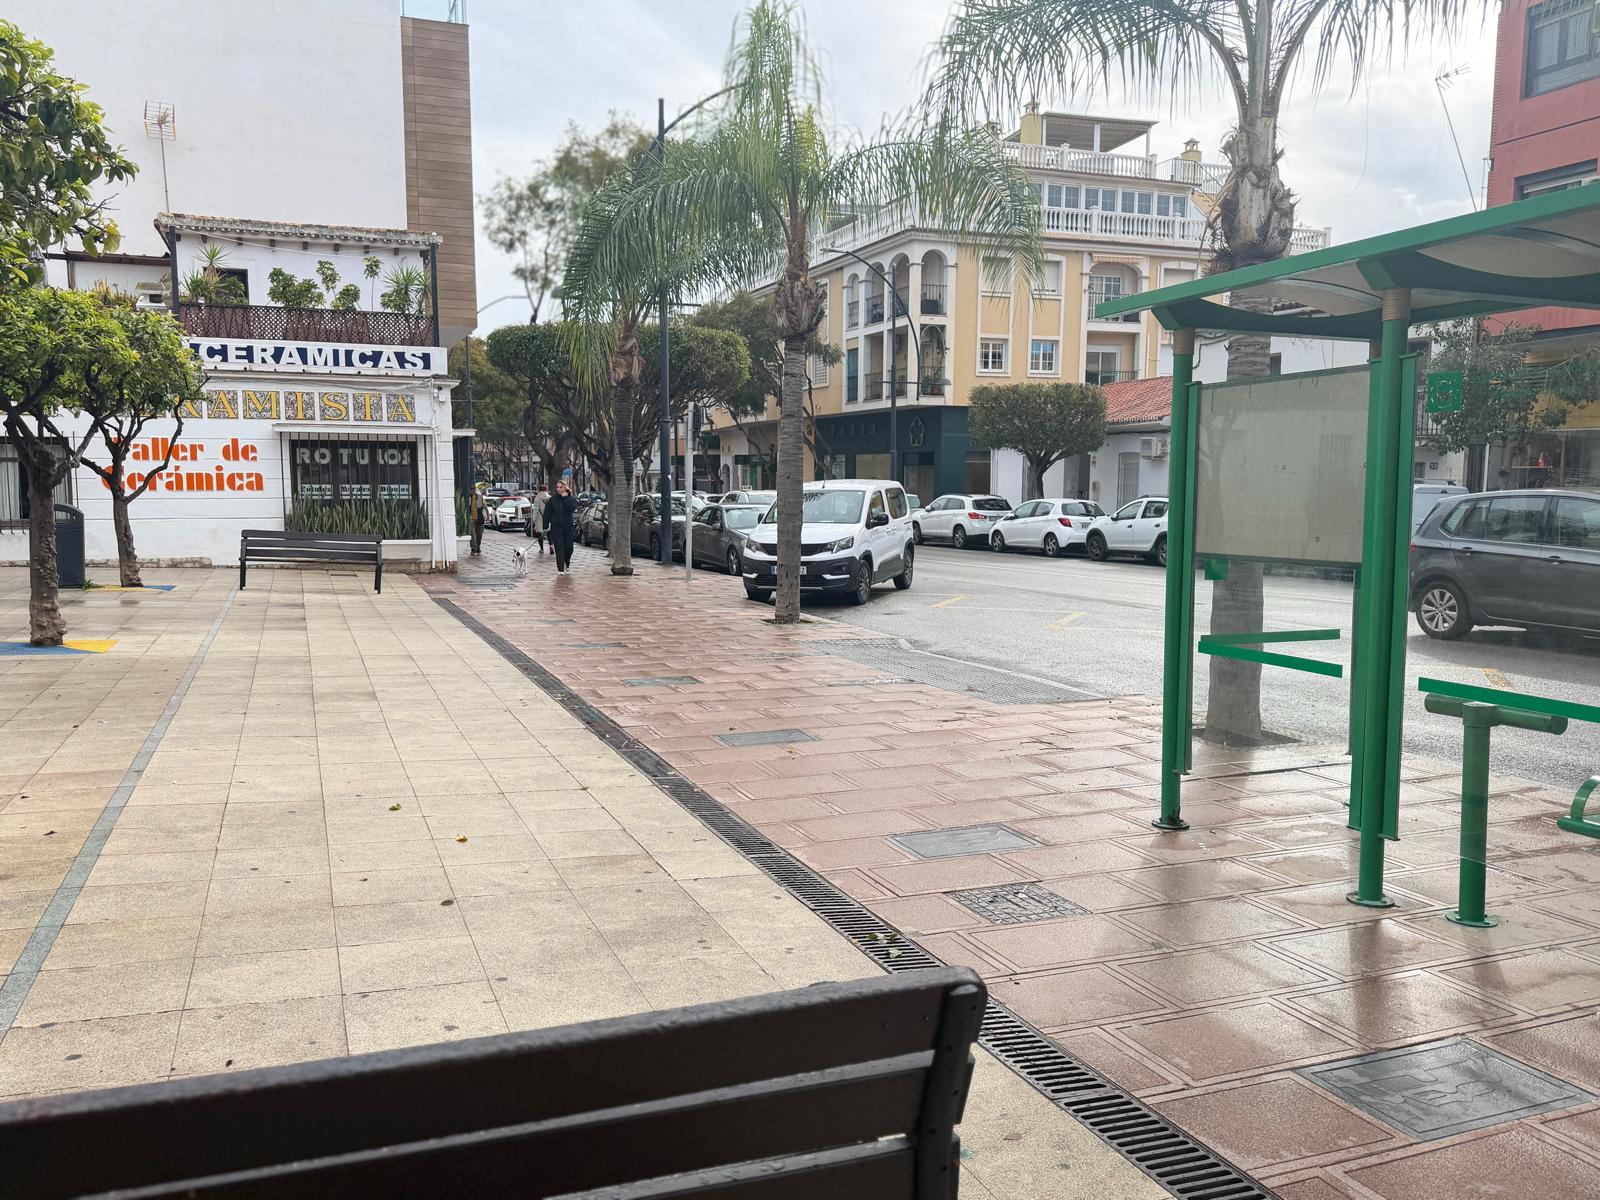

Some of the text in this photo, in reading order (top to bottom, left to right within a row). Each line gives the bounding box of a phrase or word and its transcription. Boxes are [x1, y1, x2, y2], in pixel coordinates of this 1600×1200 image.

[199, 343, 424, 370] CERAMICAS
[112, 437, 258, 461] aller de
